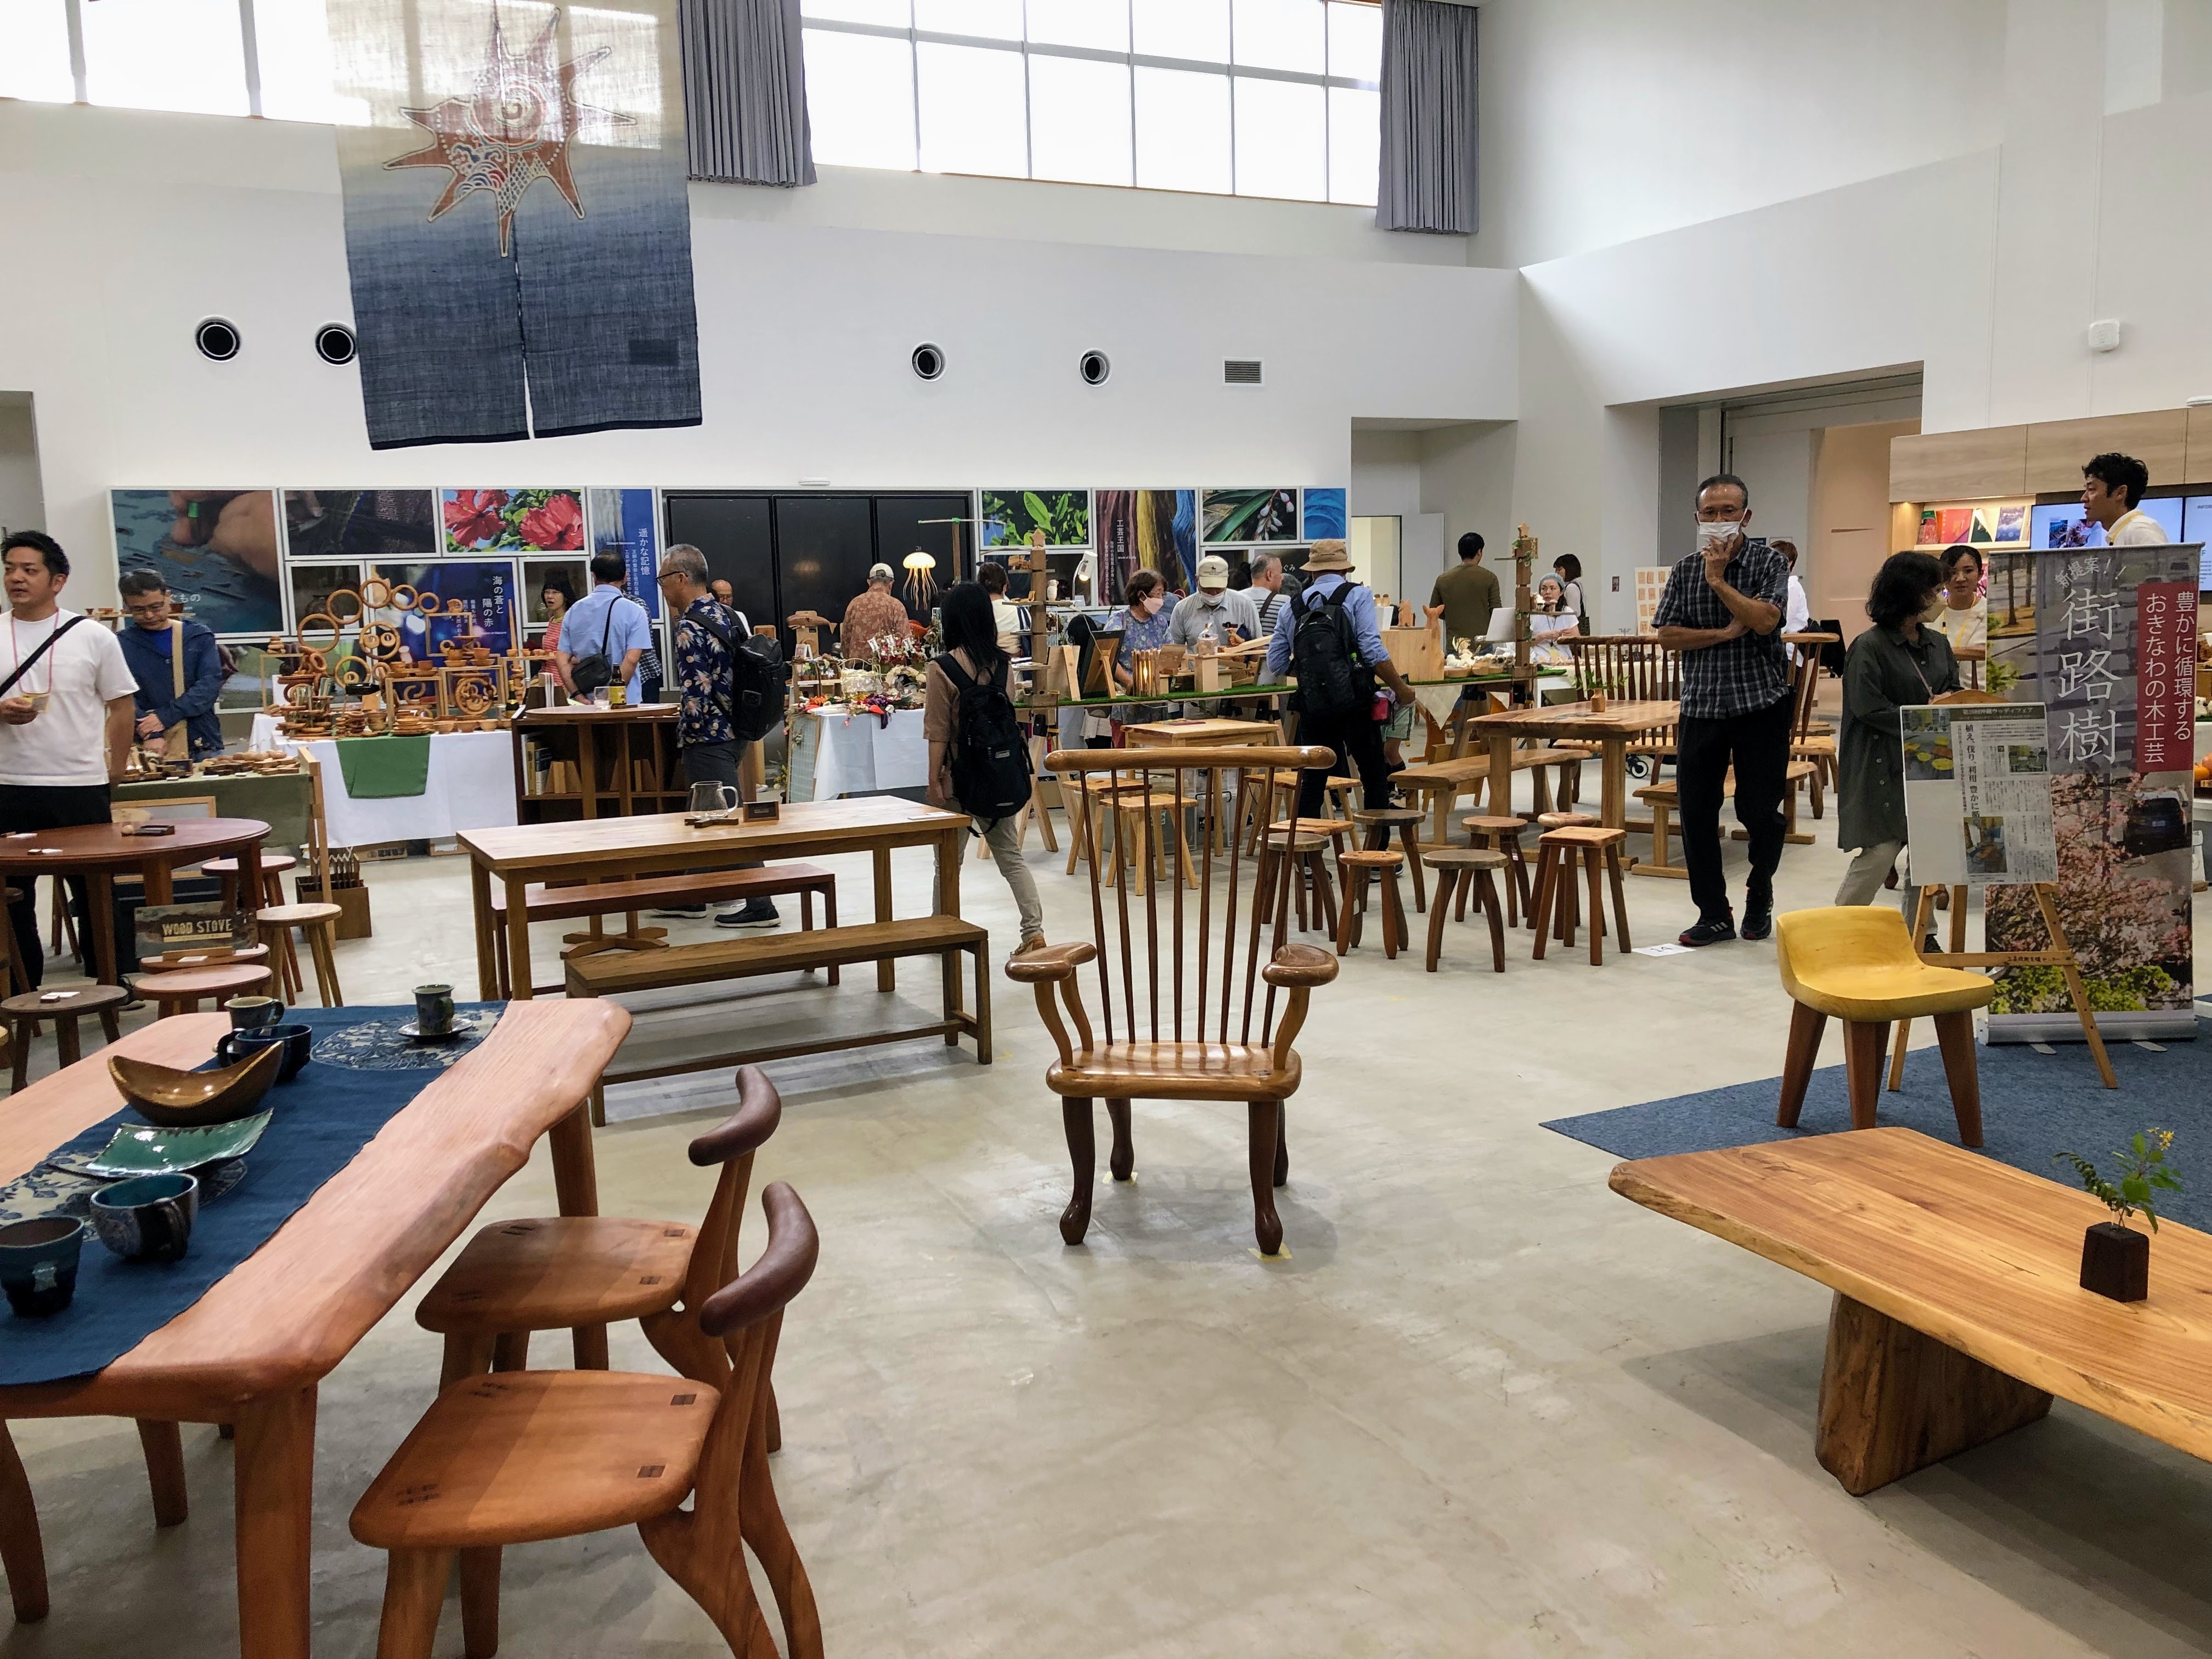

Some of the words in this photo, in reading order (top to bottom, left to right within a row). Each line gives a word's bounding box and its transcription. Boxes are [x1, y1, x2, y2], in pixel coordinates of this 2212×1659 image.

[638, 528, 651, 575] 遥かな記憶
[482, 598, 494, 627] 陽の赤
[492, 576, 504, 614] 海の蒼と
[2058, 588, 2123, 764] 街路樹
[2145, 593, 2167, 764] おきなわの木工芸
[2174, 591, 2195, 741] 豊かに循環する
[162, 922, 193, 936] WOOD
[196, 919, 233, 933] STOVE
